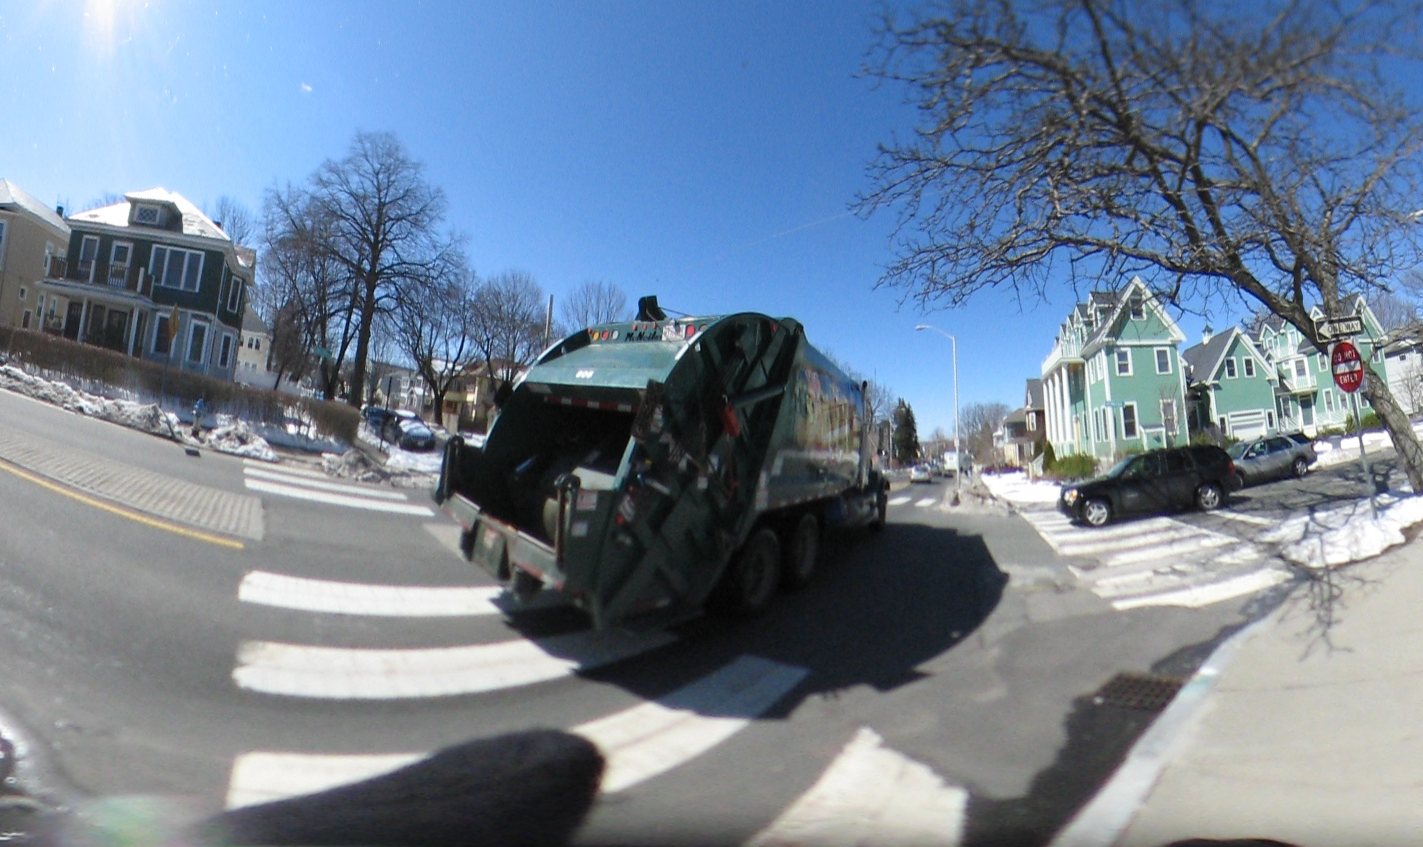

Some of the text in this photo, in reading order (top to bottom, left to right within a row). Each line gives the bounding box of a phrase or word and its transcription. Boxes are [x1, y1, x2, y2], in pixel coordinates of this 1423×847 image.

[1345, 320, 1359, 331] WAY
[1334, 350, 1356, 362] DO NOT
[1340, 374, 1357, 385] ENTER
